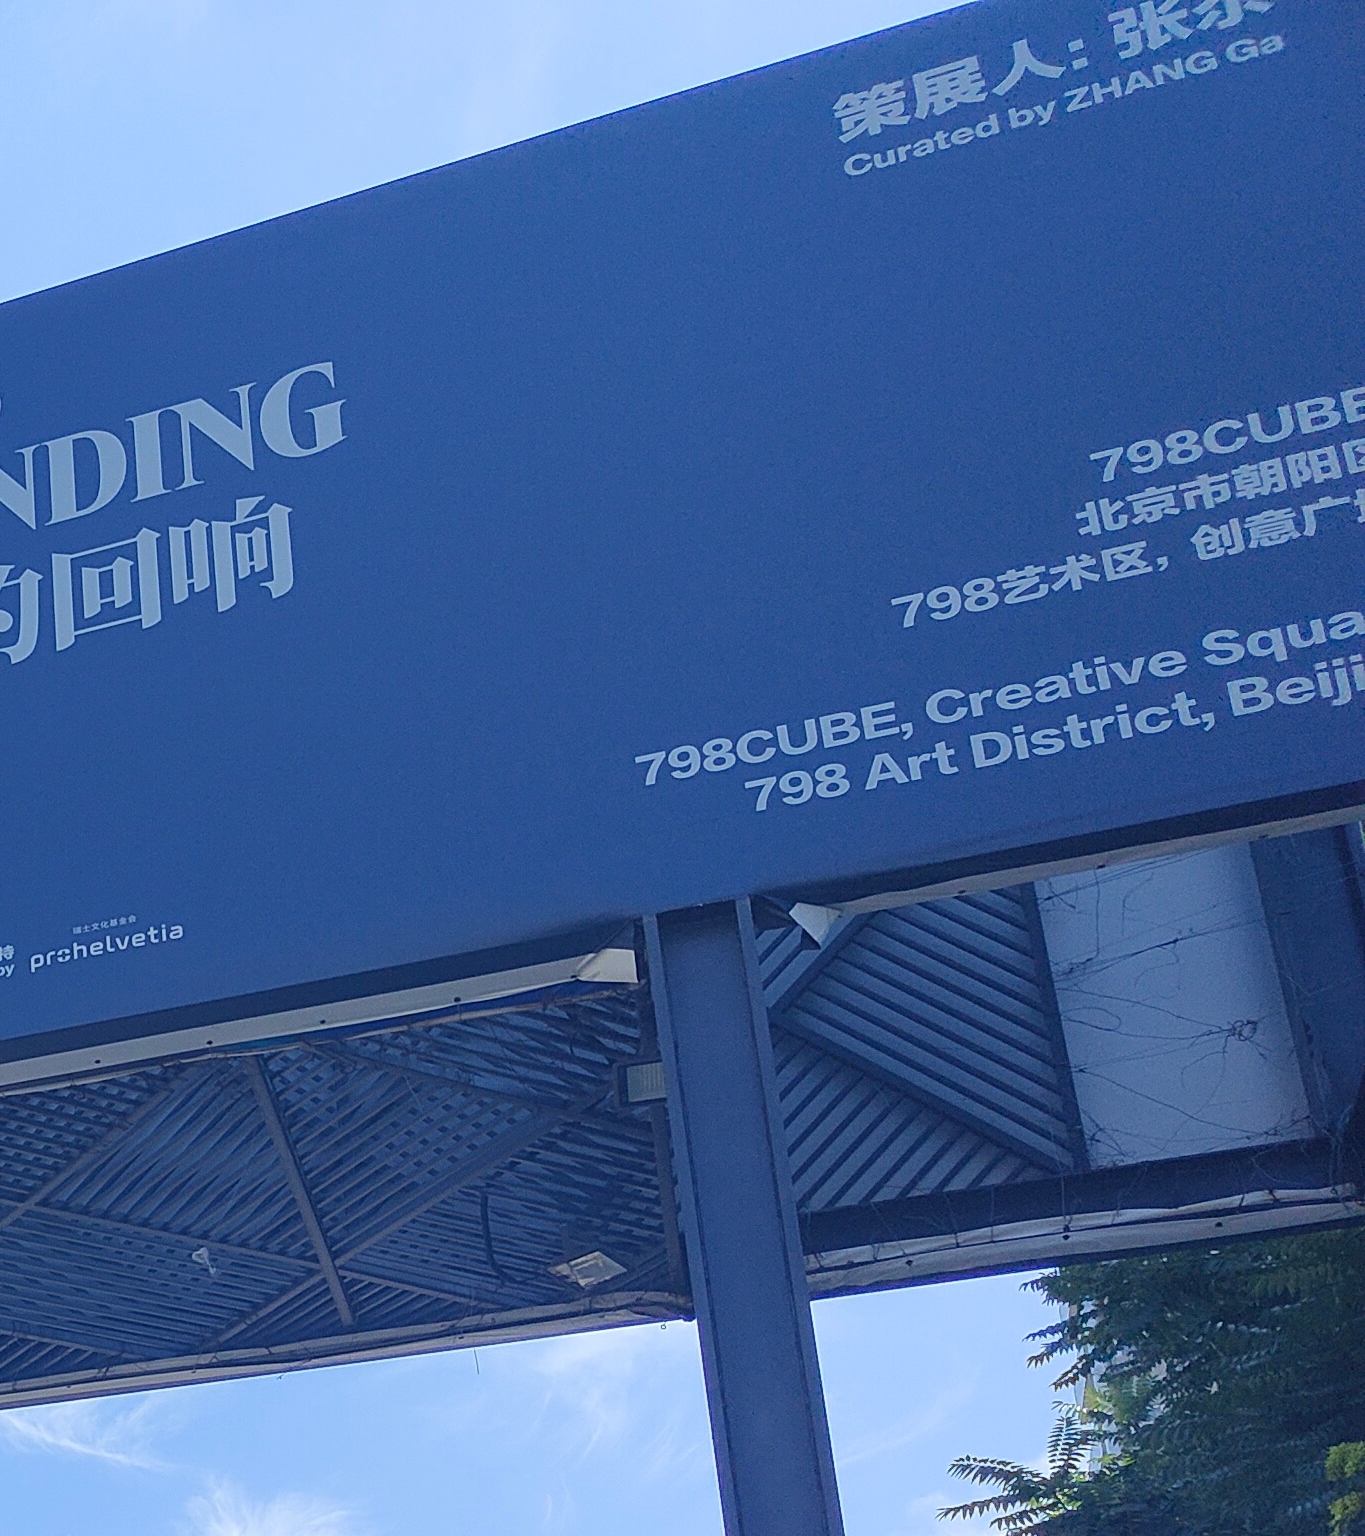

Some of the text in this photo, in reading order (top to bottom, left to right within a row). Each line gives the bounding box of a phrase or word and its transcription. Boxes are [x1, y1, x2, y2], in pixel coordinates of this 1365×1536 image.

[844, 34, 1284, 176] Curated by ZHANG Ga
[891, 488, 1365, 628] 798艺术区，创意广
[635, 702, 913, 785] 798CUBE,
[925, 648, 1187, 725] Creative
[744, 764, 850, 811] 798
[865, 740, 959, 790] Art
[970, 695, 1215, 769] District,
[30, 923, 184, 973] prohelvetia
